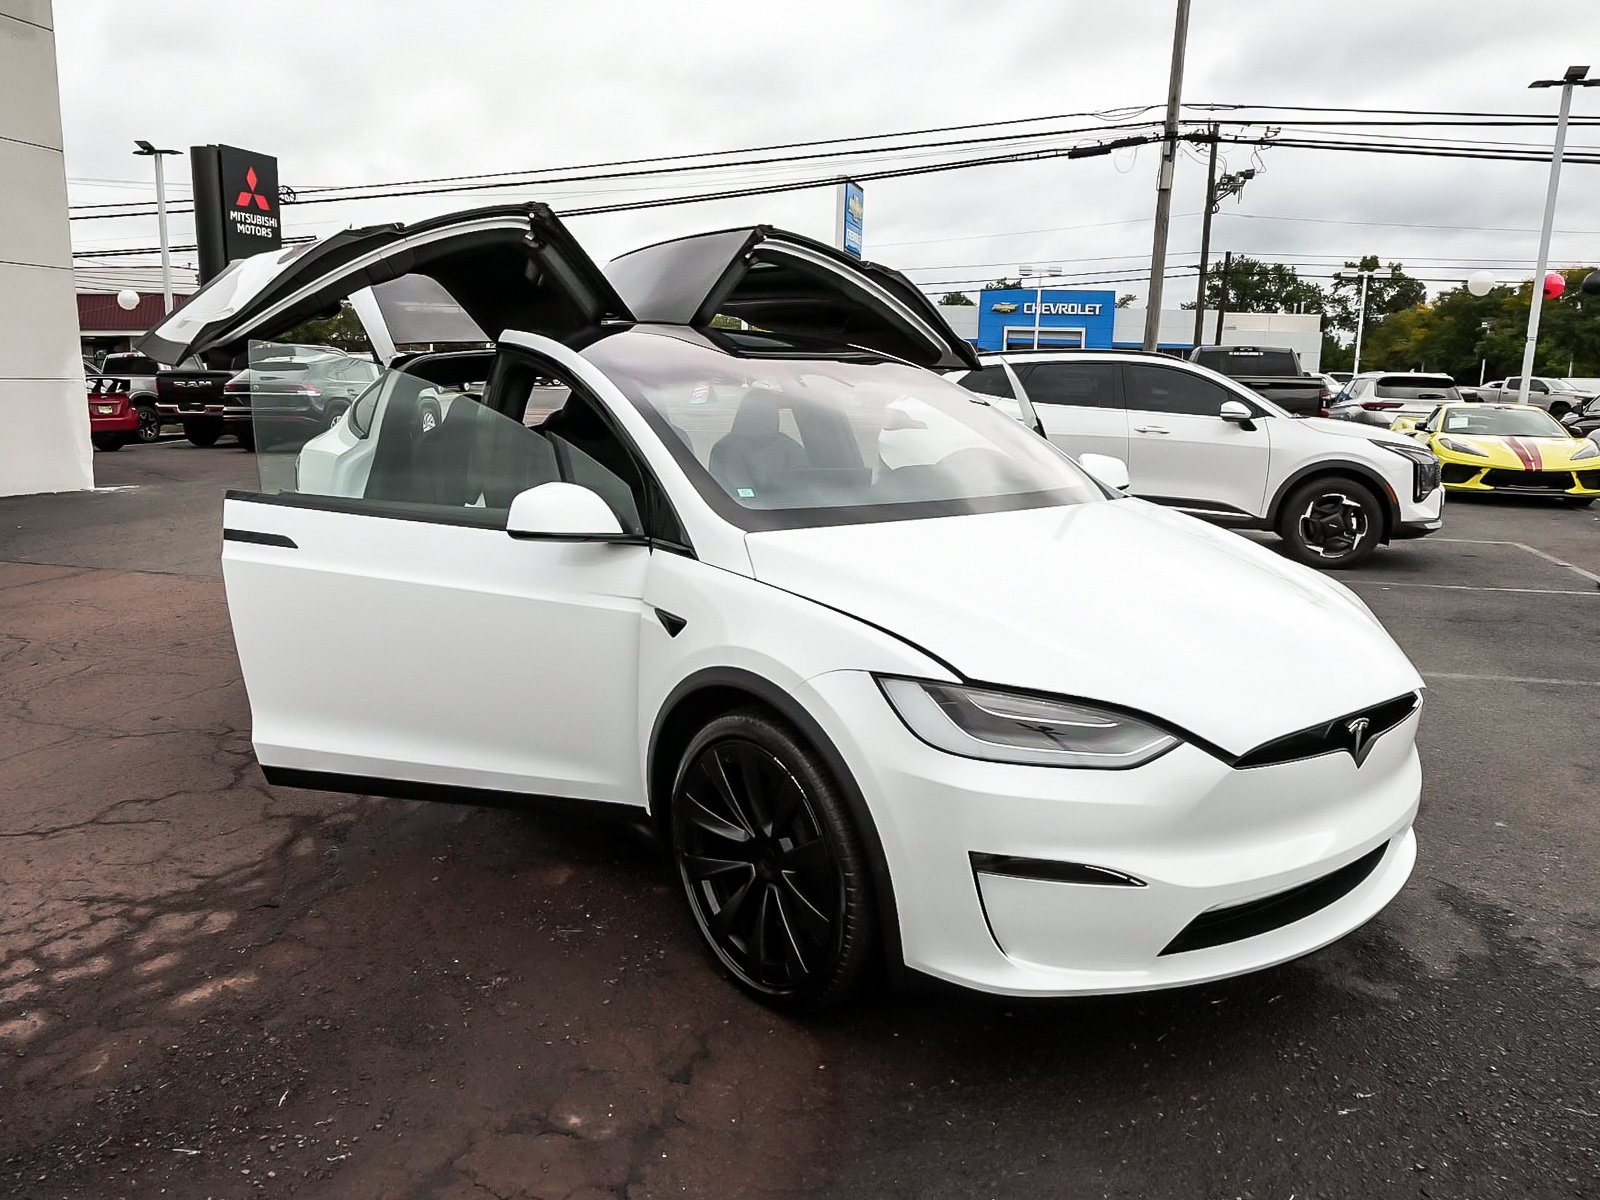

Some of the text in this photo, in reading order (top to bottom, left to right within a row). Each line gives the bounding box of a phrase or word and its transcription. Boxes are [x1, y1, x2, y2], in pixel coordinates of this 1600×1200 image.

[230, 210, 278, 228] MITSUBISHI
[237, 223, 272, 238] MOTORS
[1023, 302, 1102, 315] CHEVROLET
[173, 380, 212, 388] RAM
